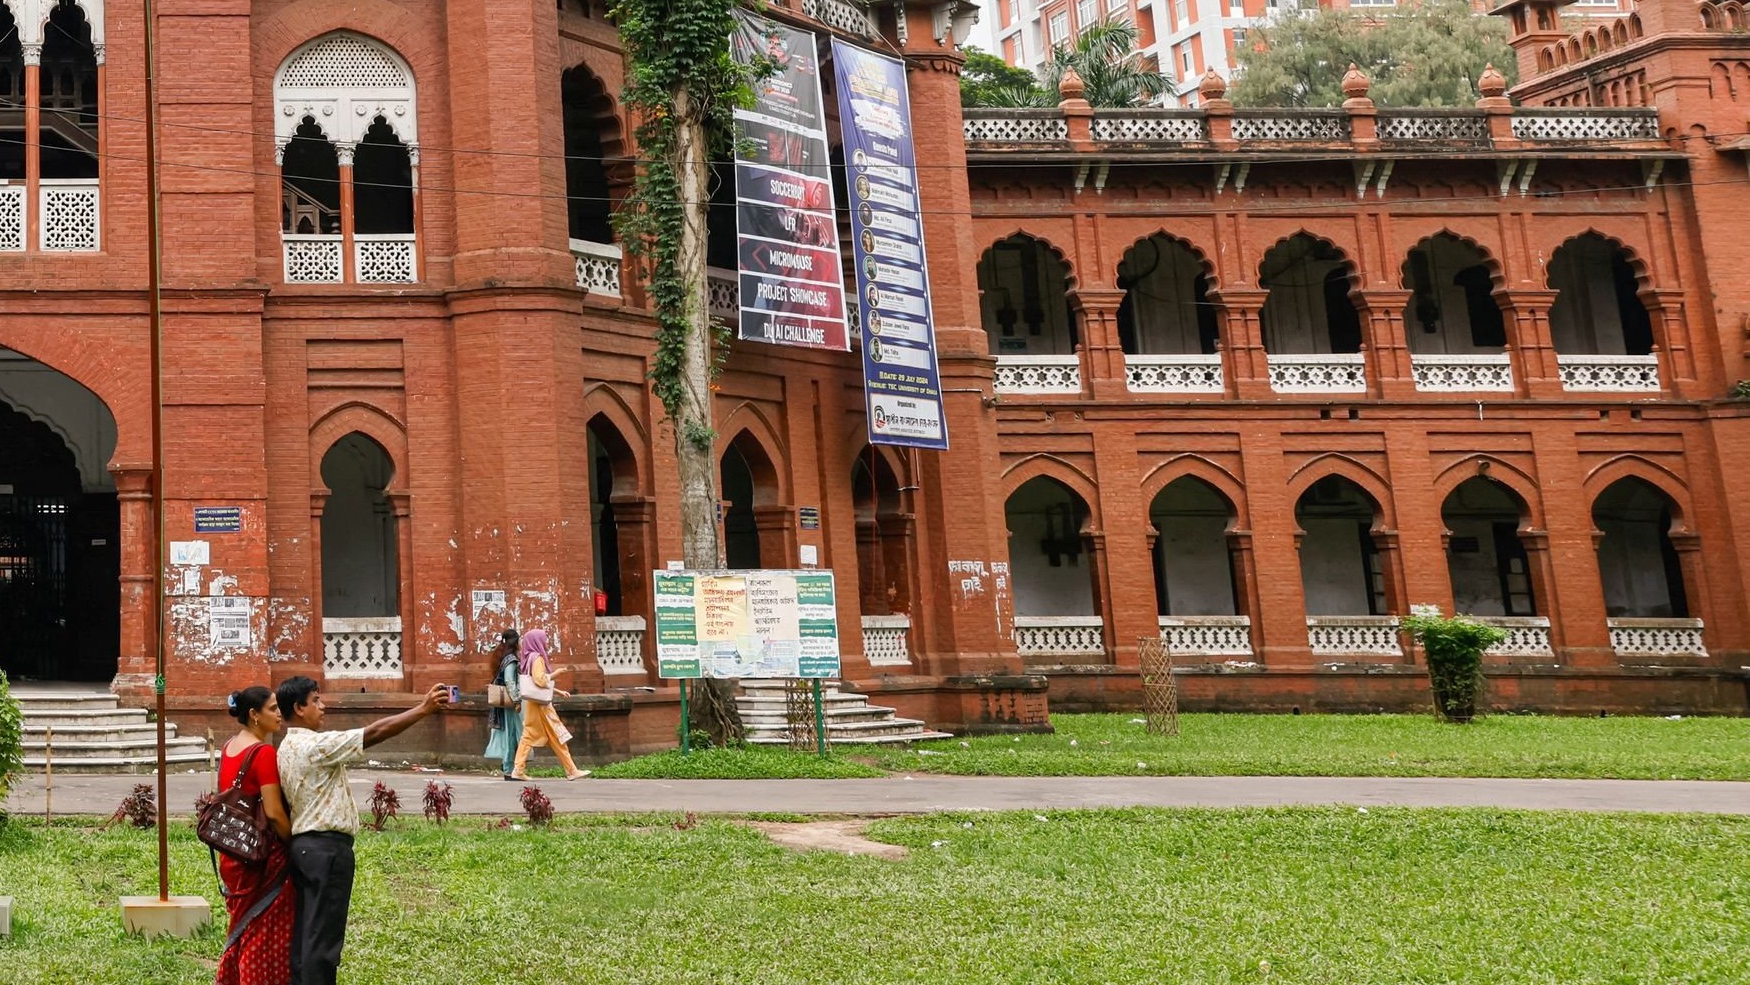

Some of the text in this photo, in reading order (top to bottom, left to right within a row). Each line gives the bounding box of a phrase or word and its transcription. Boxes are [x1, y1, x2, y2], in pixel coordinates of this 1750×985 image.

[784, 216, 796, 232] LFR
[769, 249, 813, 272] MICROMOUSE
[757, 282, 827, 307] PROJECT SHOWCASE
[784, 325, 825, 344] CHALLENGE
